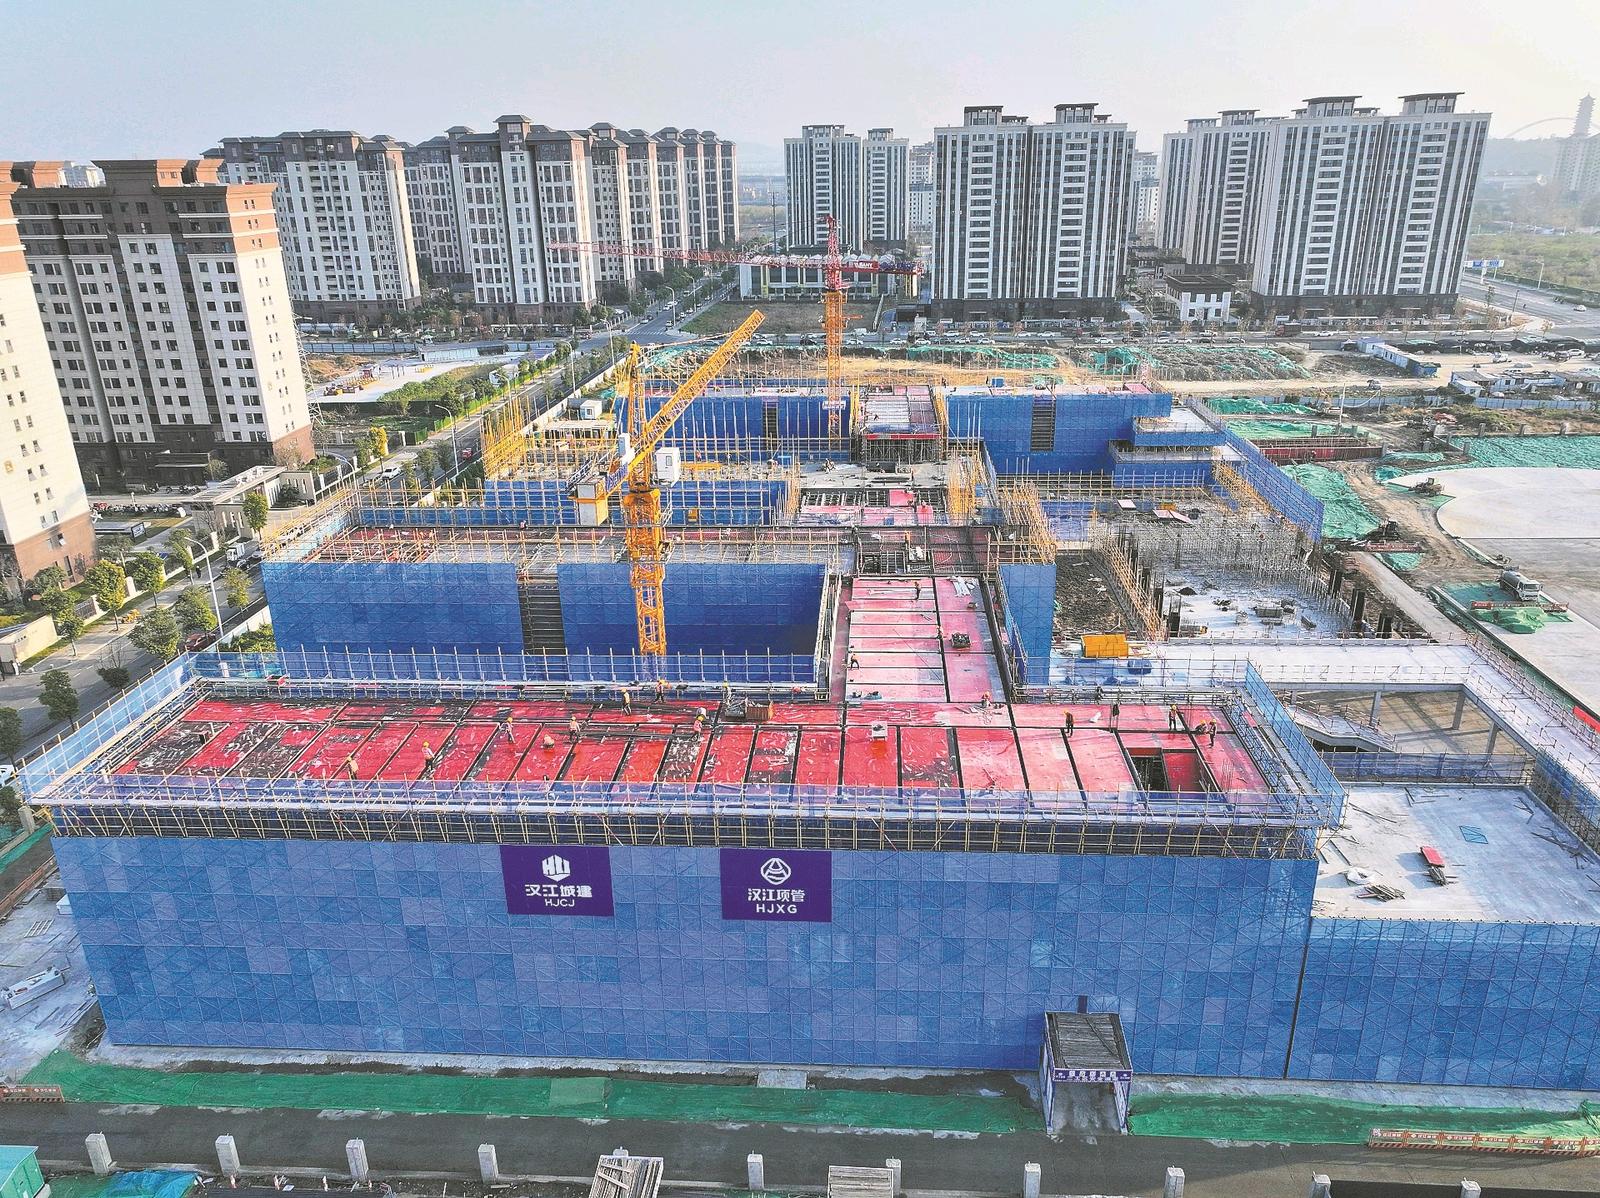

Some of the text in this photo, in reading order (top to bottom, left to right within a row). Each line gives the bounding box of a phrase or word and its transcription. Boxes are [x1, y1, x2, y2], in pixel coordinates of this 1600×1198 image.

[524, 884, 593, 898] 汉江城建
[747, 888, 806, 903] 汉江项管
[544, 898, 575, 907] HJCJ
[756, 903, 798, 914] HJXG
